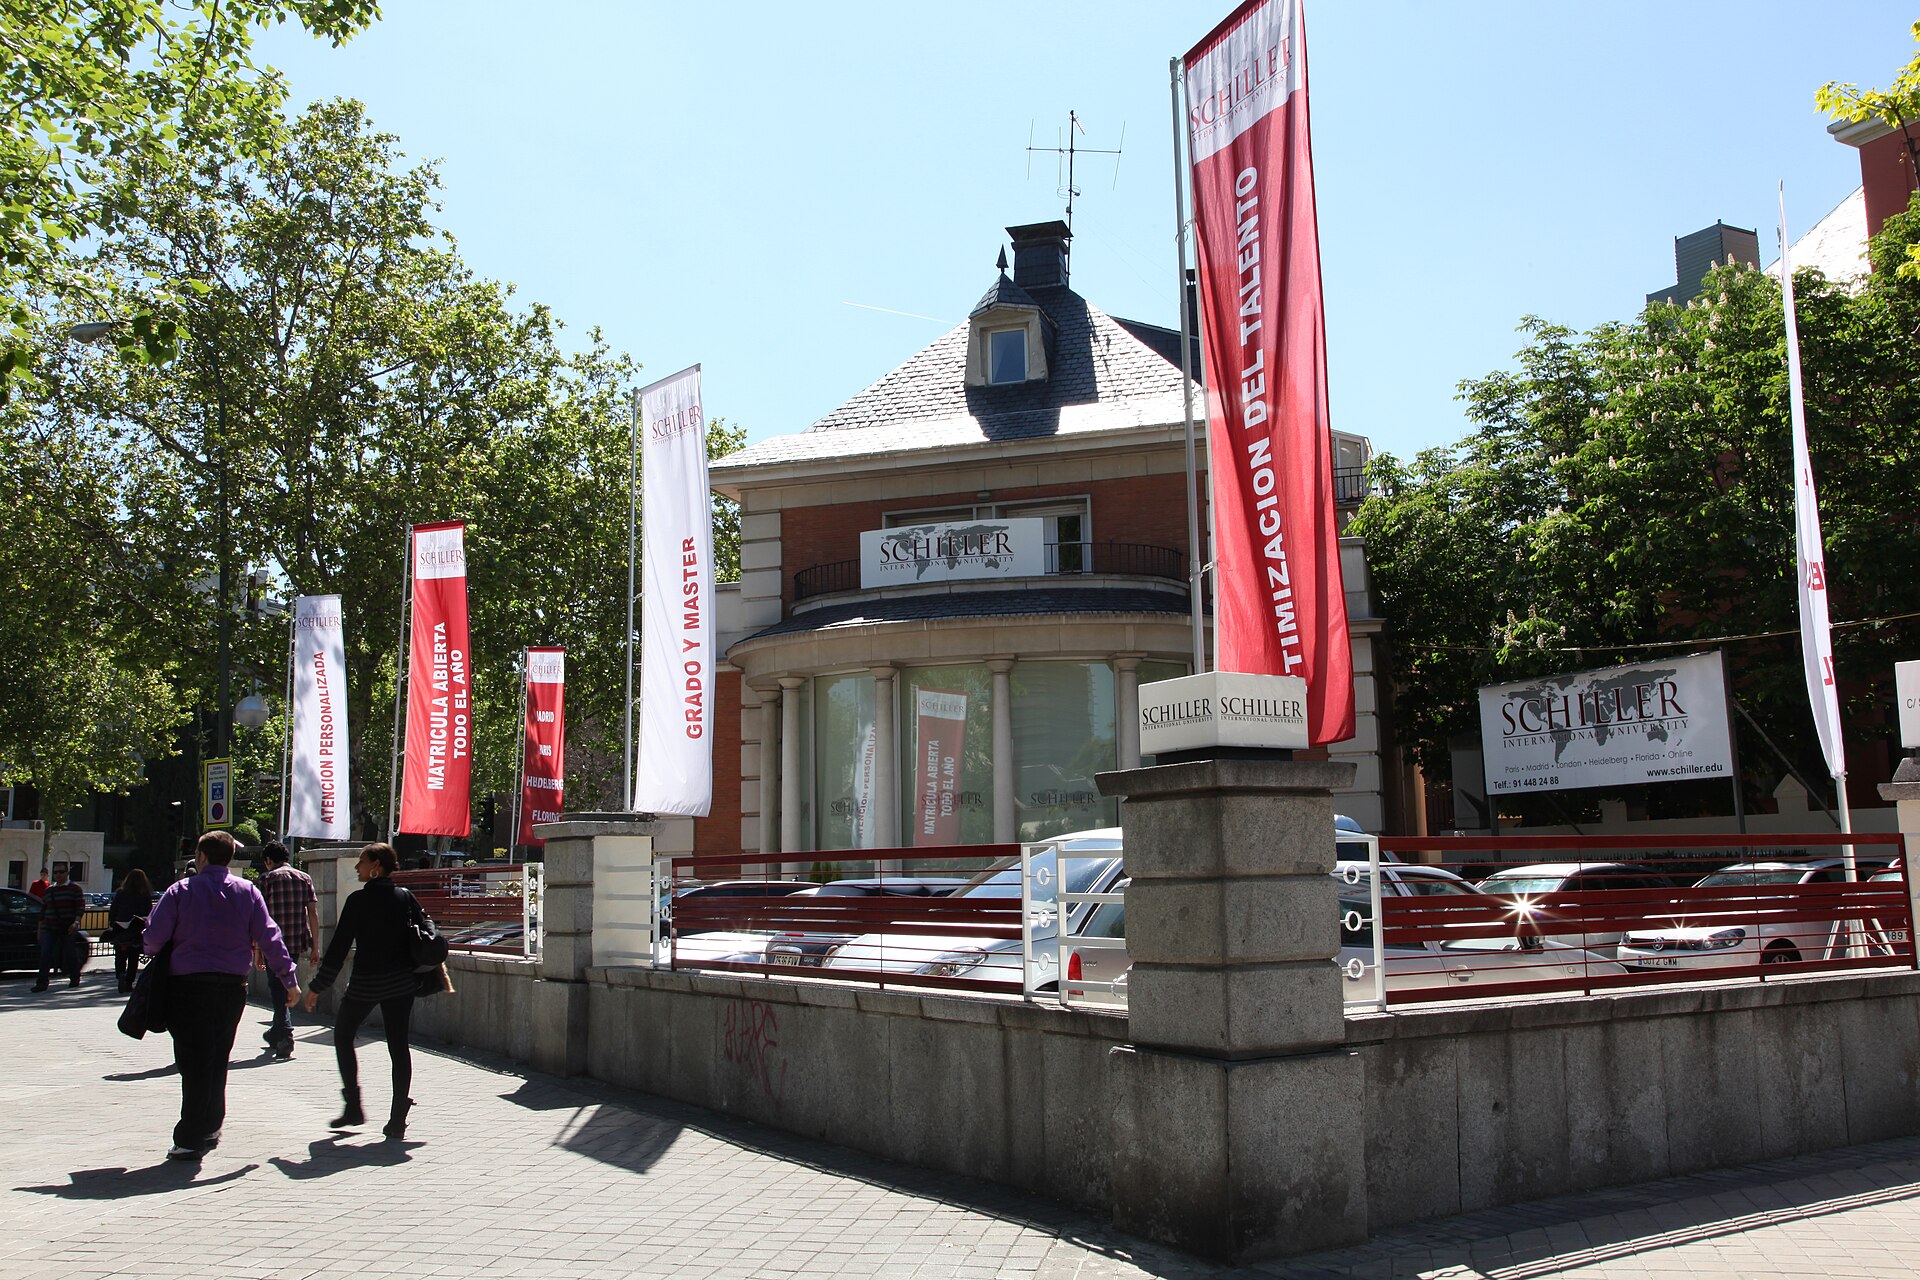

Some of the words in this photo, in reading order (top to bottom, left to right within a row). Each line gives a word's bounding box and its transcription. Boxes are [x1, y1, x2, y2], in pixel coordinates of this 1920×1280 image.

[1235, 166, 1262, 347] TALENTO
[1241, 349, 1267, 430] DEL
[652, 405, 700, 440] SCHILLER
[420, 549, 464, 565] SCHILLER
[880, 532, 1014, 563] SCHILLER
[1247, 436, 1303, 678] TIMIZACION
[682, 536, 700, 630] MASTER
[298, 616, 341, 628] SCHILLER
[432, 621, 449, 692] ABIERTA
[682, 639, 701, 653] Y
[450, 649, 467, 685] AÑO
[313, 651, 334, 756] PERSONALIZADA
[454, 689, 467, 709] EL
[684, 661, 703, 740] GRADO
[921, 700, 965, 713] SCHILLER
[1142, 698, 1212, 724] SCHILLER
[1220, 697, 1303, 717] SCHILLER
[1501, 681, 1688, 736] SCHILLER
[1143, 720, 1181, 731] INTERNATIONAL
[1221, 715, 1267, 723] INTERNATIONAL
[1607, 719, 1689, 739] UNIVERSITY
[427, 696, 449, 790] MATRICULA
[453, 714, 467, 759] TODO
[927, 740, 939, 779] ABIERTA
[1505, 766, 1520, 774] Paris
[1526, 763, 1550, 772] Madrid
[1556, 759, 1582, 769] London
[1589, 755, 1628, 767] Heidelberg
[1635, 753, 1660, 762] Florida
[1668, 749, 1693, 759] Online
[1646, 762, 1723, 777] www.schiller.edu
[320, 760, 335, 824] ATENCION
[943, 778, 954, 790] EL
[1493, 780, 1511, 790] Telf.:
[1513, 780, 1521, 788] 91
[1524, 778, 1537, 787] 448
[1539, 777, 1548, 786] 24
[1550, 776, 1559, 785] 88
[923, 781, 938, 835] MATRICULA
